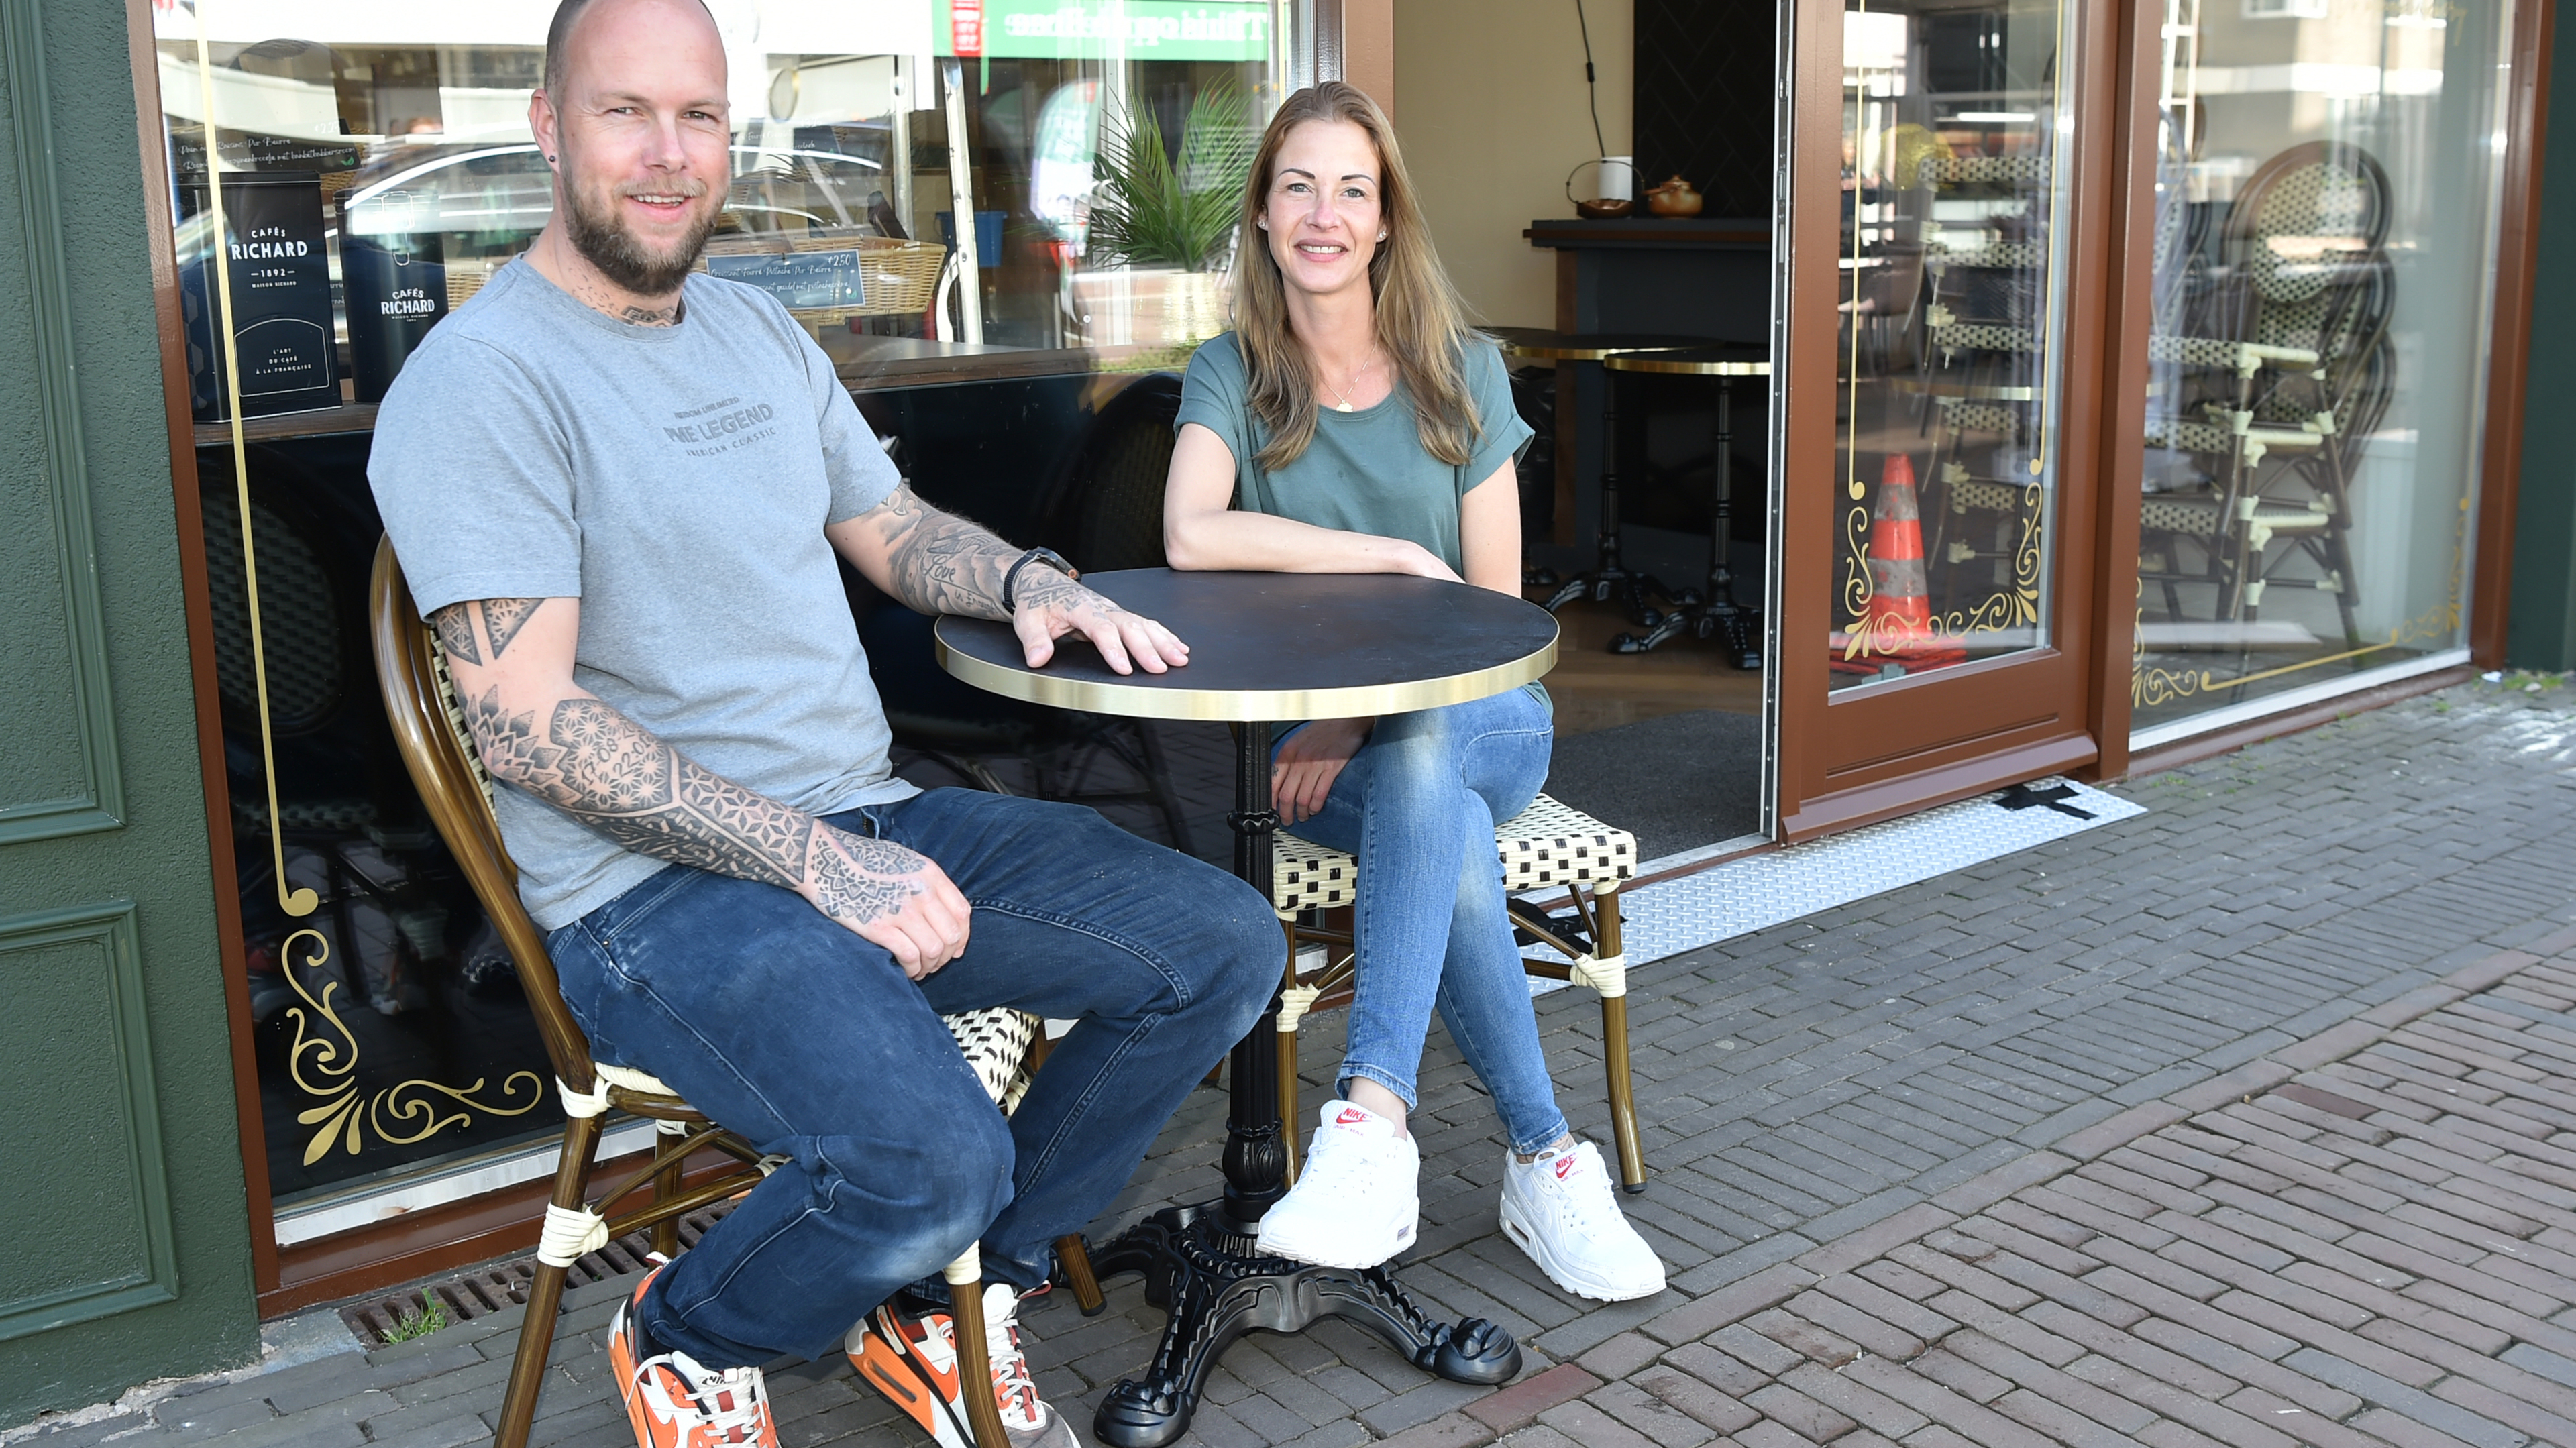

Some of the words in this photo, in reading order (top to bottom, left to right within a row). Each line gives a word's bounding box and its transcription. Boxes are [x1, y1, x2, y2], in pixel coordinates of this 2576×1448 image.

[262, 136, 291, 147] Beurre
[251, 226, 286, 238] CAFÉS
[231, 241, 308, 260] RICHARD
[828, 254, 851, 267] €2.50
[392, 288, 425, 300] CAFÉS
[380, 299, 435, 315] RICHARD
[280, 355, 298, 364] CAFÉ
[274, 364, 312, 373] FRANÇAISE
[698, 403, 774, 441] LEGEND
[732, 427, 777, 449] CLASSIC
[922, 554, 956, 583] Love
[1343, 1107, 1369, 1122] NIKE
[1555, 1154, 1574, 1170] NIKE
